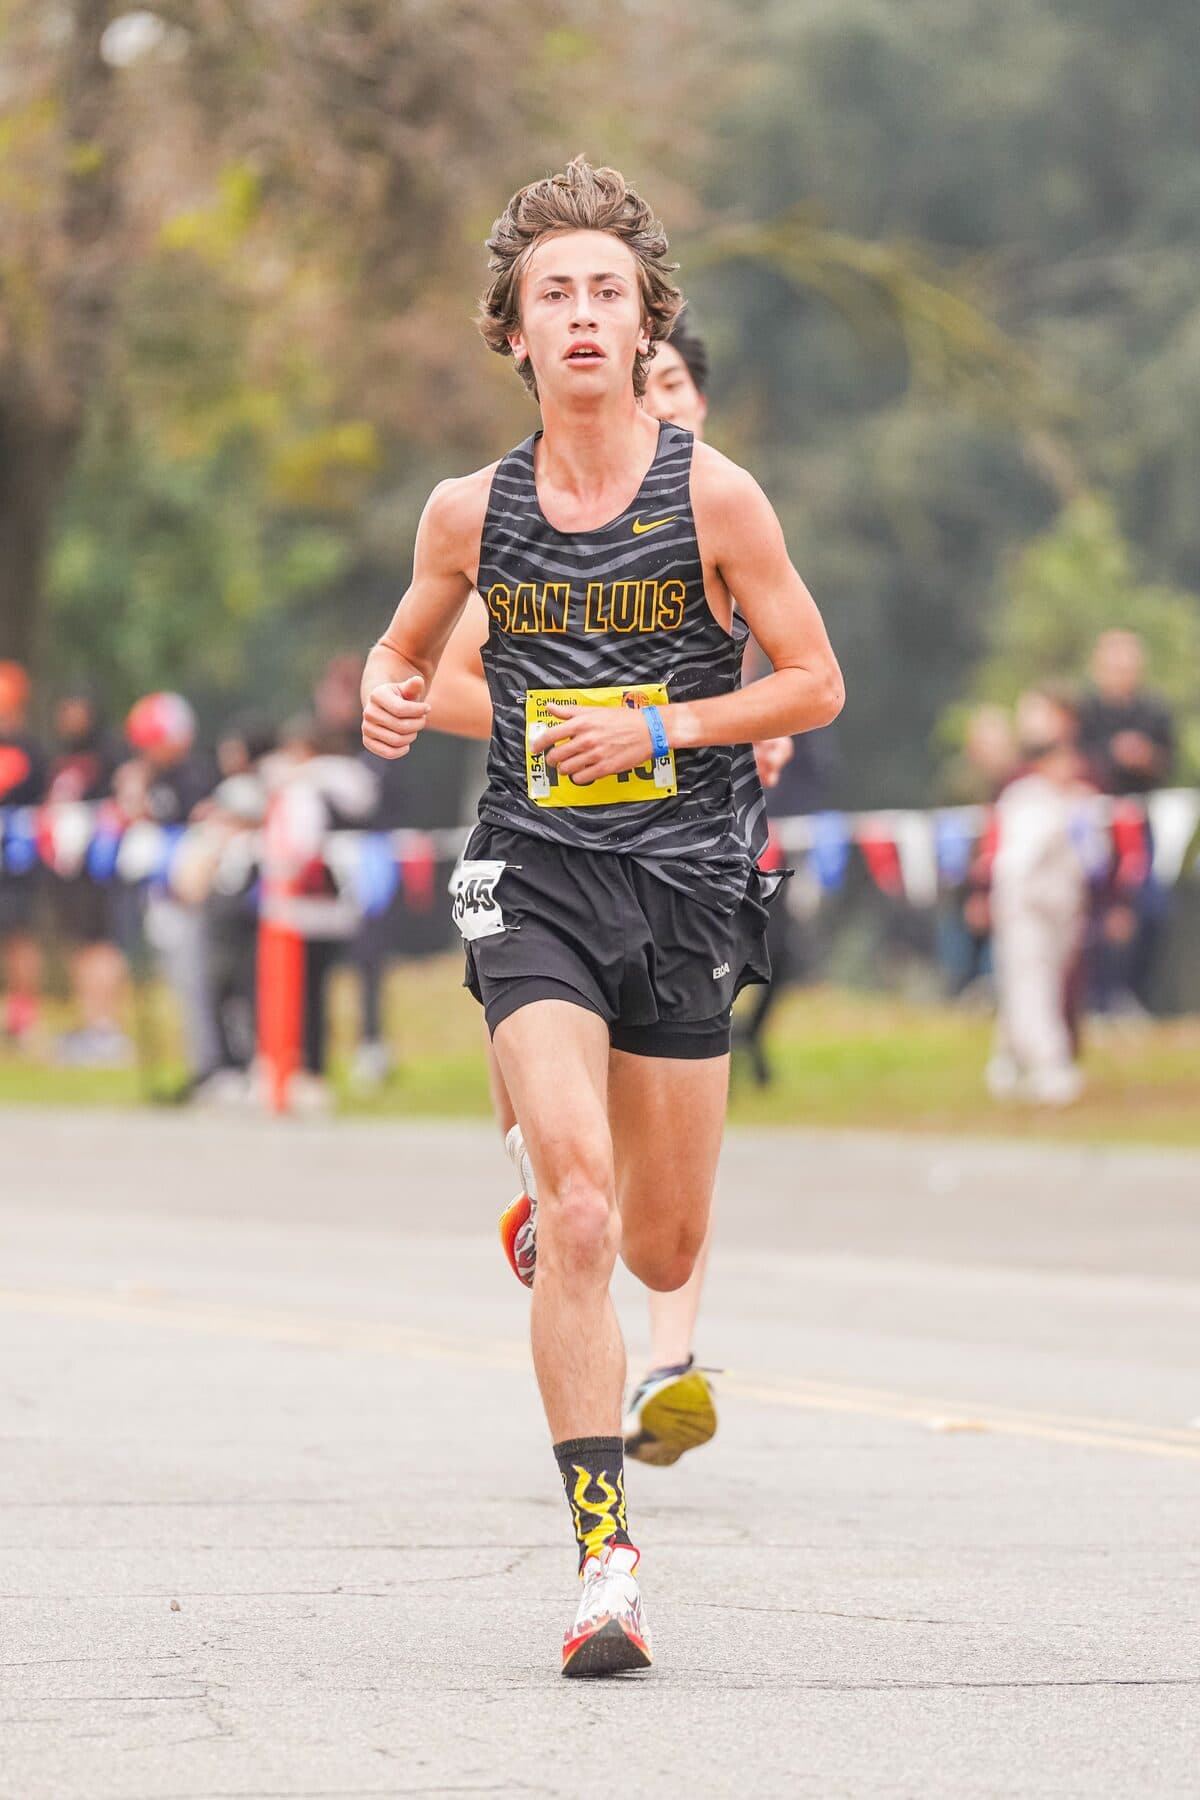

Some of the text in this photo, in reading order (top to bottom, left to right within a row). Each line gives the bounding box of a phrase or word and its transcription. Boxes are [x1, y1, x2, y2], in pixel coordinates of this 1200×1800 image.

[487, 579, 686, 633] SAN LUIS
[454, 879, 496, 919] 545
